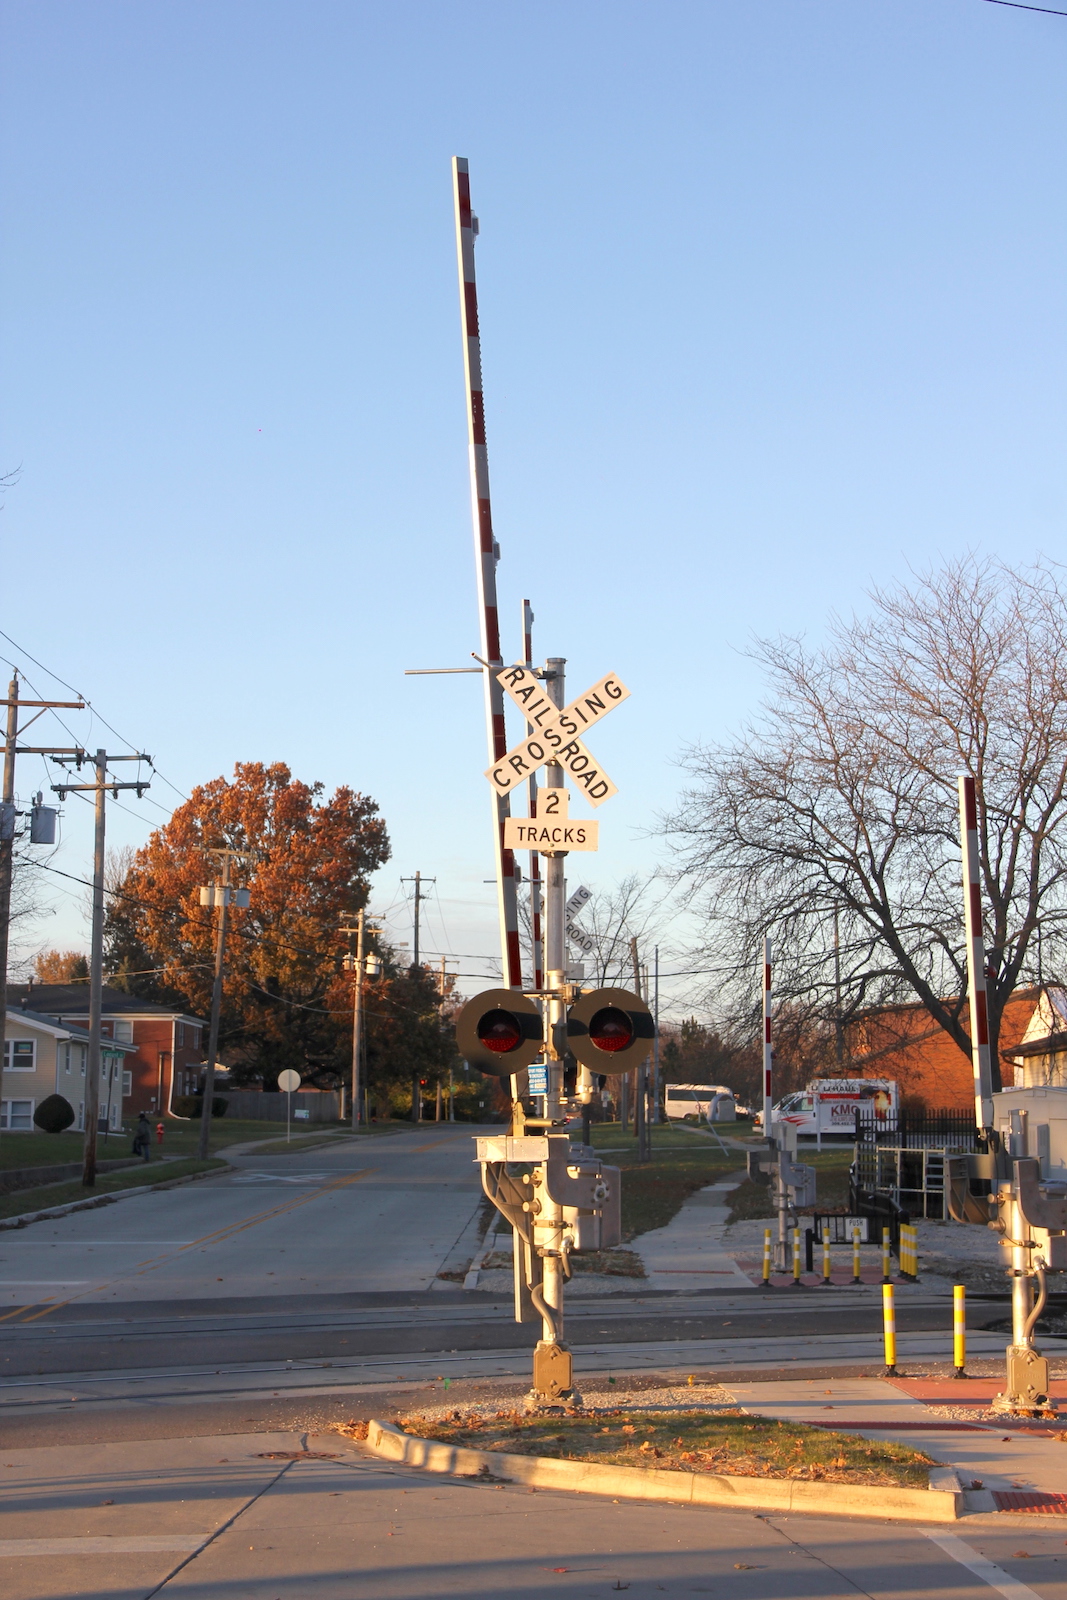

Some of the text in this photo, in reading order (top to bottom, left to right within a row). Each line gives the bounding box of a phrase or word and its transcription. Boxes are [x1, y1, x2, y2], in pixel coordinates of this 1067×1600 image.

[493, 680, 622, 787] CROSSING
[504, 666, 609, 799] RAIL ROAD
[545, 793, 560, 814] 2
[517, 826, 586, 843] TRACKS
[565, 923, 593, 951] ROAD
